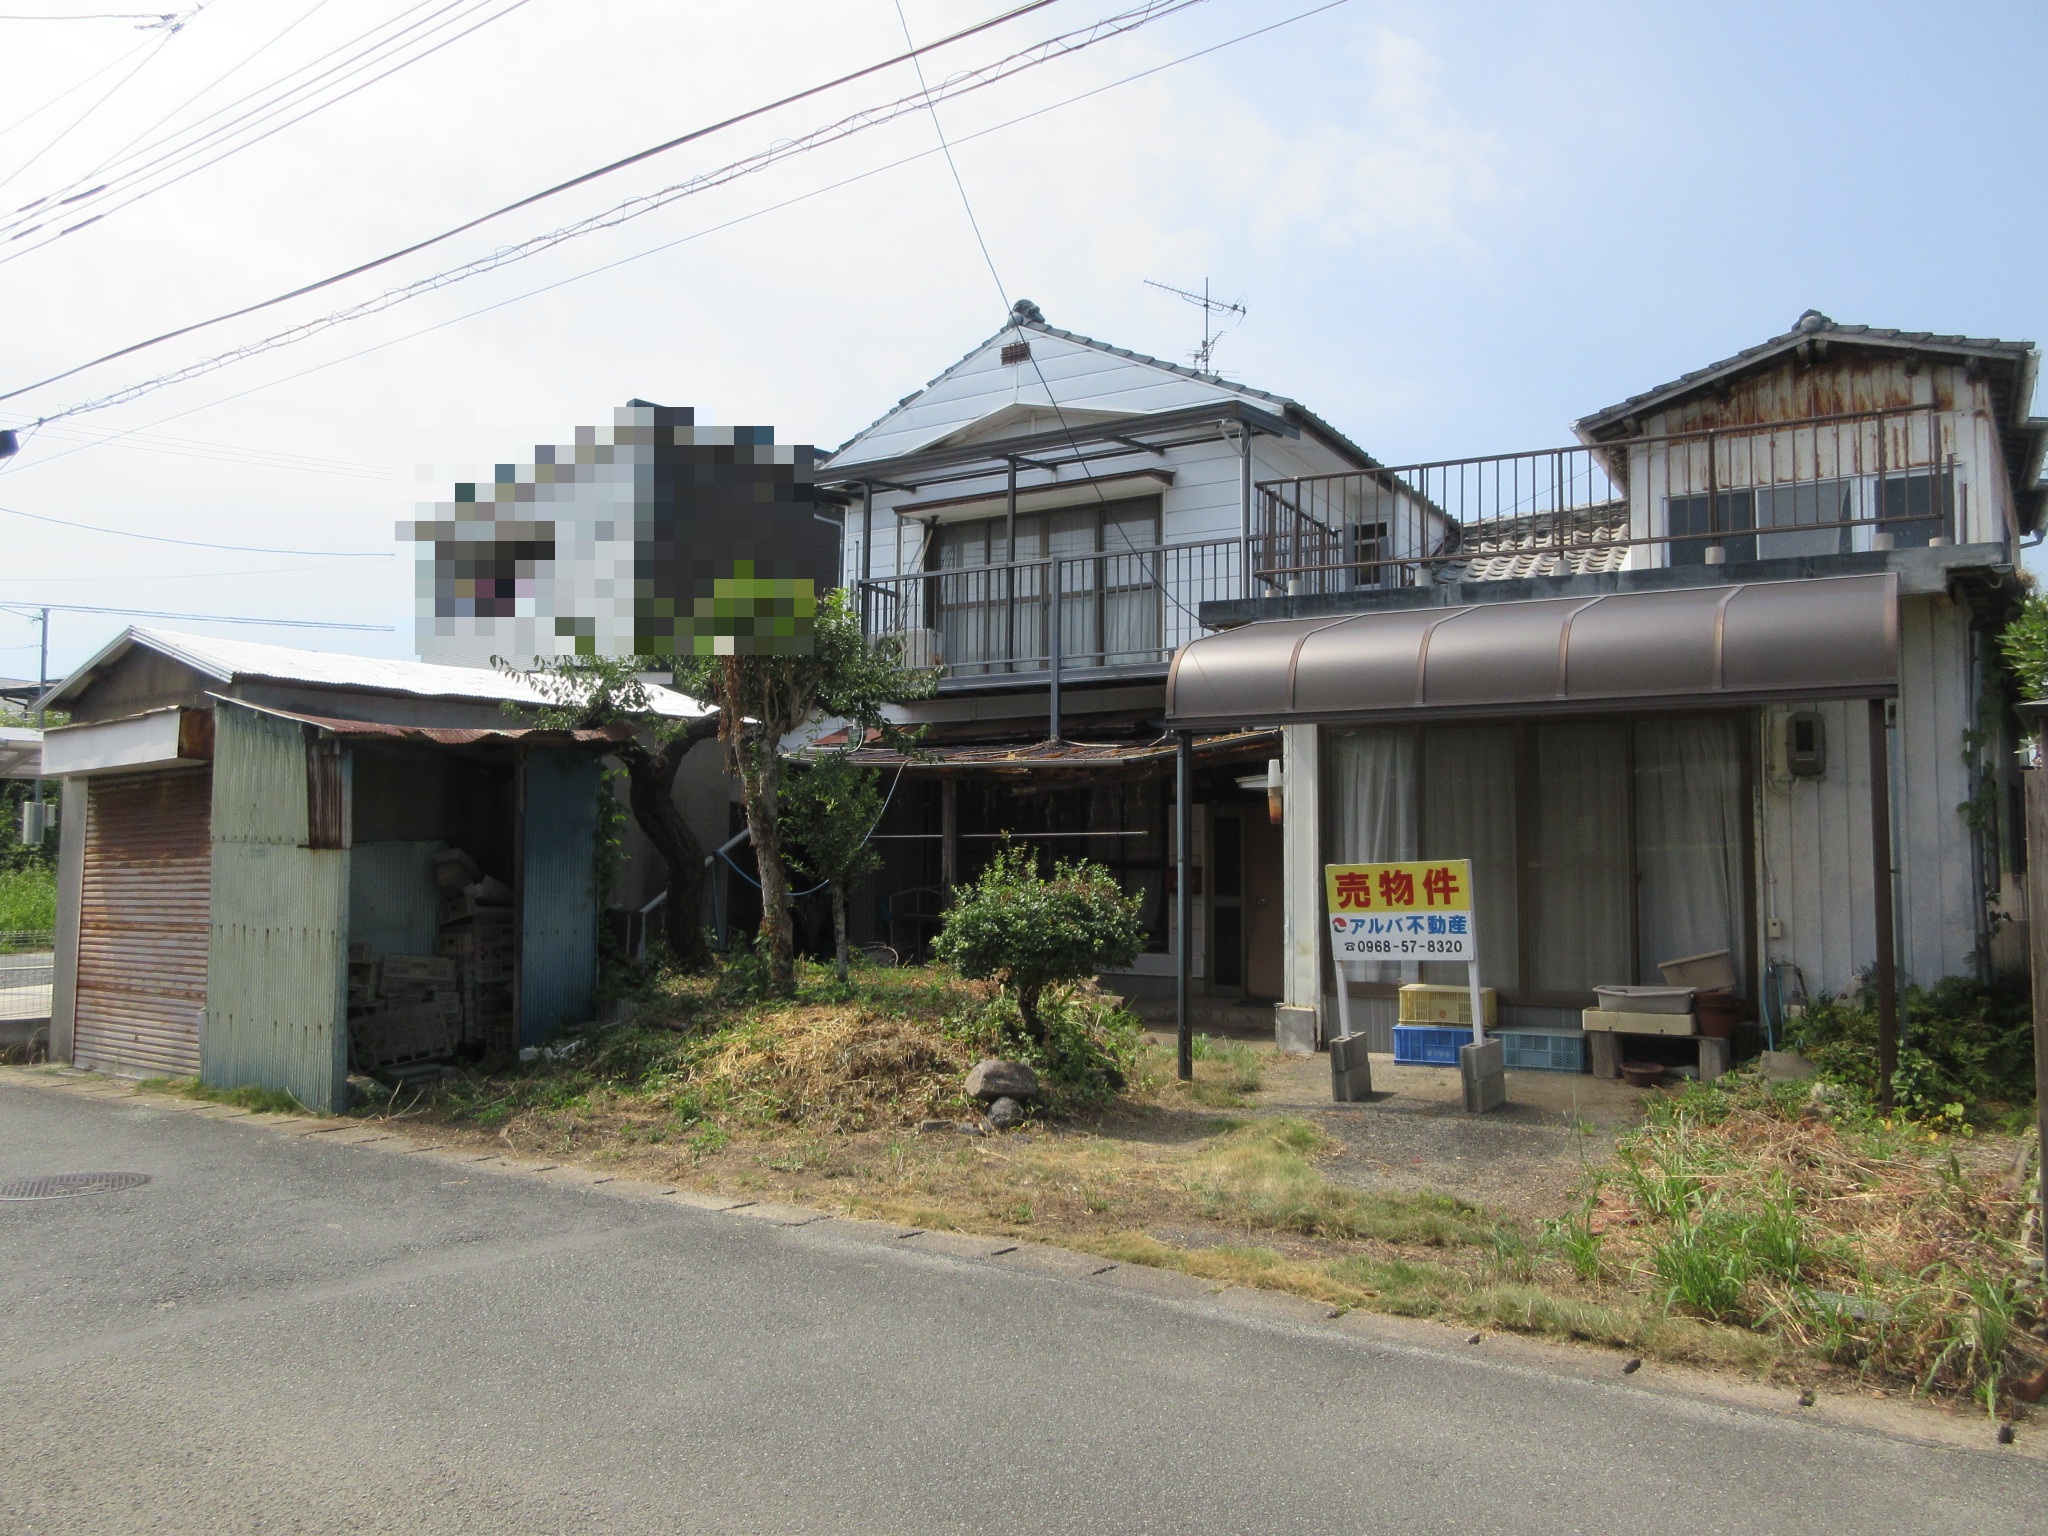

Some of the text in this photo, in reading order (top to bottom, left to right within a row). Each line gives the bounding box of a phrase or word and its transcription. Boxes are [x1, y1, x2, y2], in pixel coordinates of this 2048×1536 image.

[1335, 867, 1459, 909] 売物件
[1349, 915, 1467, 935] アルバ不動産
[1357, 940, 1462, 953] 0968-57-8320
